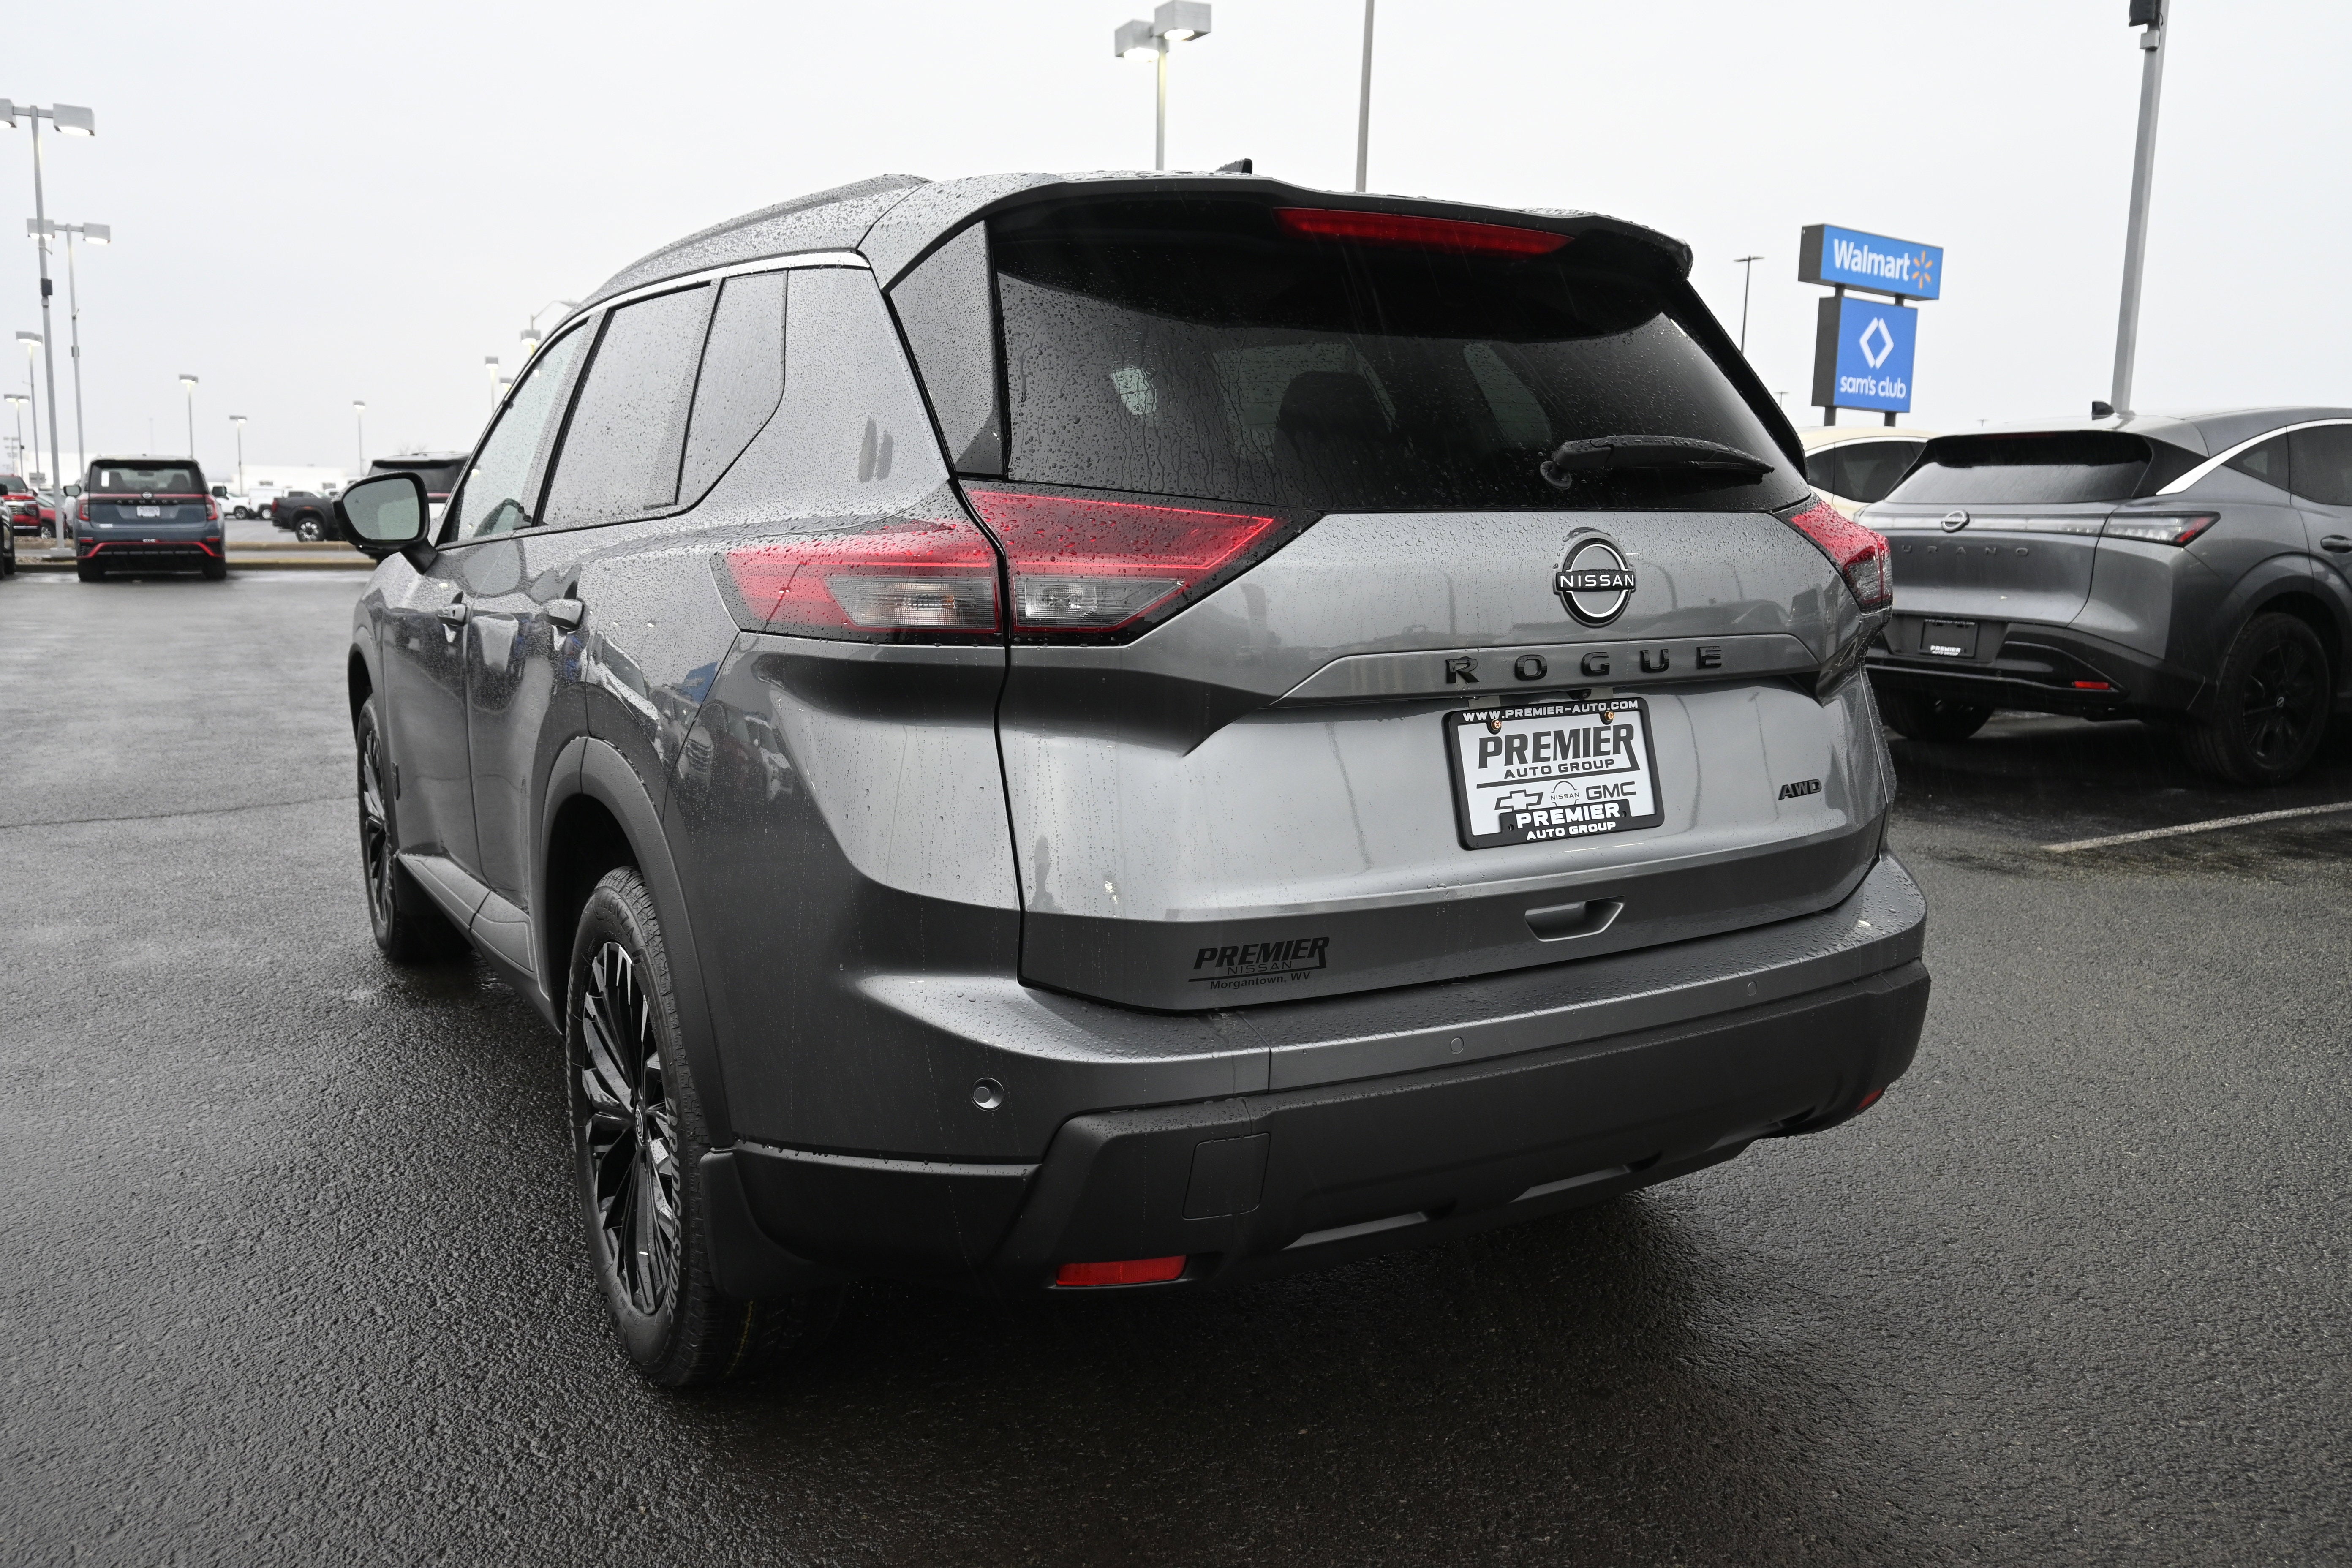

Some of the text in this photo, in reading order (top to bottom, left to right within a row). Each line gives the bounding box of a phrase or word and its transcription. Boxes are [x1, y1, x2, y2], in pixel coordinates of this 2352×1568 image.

[1833, 238, 1910, 281] Walmart
[1840, 375, 1906, 399] sam's club
[1902, 545, 2029, 556] URANO
[1560, 573, 1635, 588] NISSAN
[1445, 645, 1722, 684] ROGUE
[1463, 700, 1638, 722] WWW.PREMIER-AUTO.COM
[1478, 724, 1639, 770] PREMIER
[1504, 759, 1615, 779] AUTO GROUP
[1550, 792, 1579, 800] NISSAN
[1585, 781, 1637, 800] GMC
[1778, 778, 1822, 800] AWD
[1516, 803, 1620, 829] PREMIER
[1526, 822, 1616, 840] AUTO GROUP
[1193, 936, 1330, 969] PREMIER
[1227, 961, 1292, 975] NISSAN
[1210, 972, 1311, 989] Morgantown, WV
